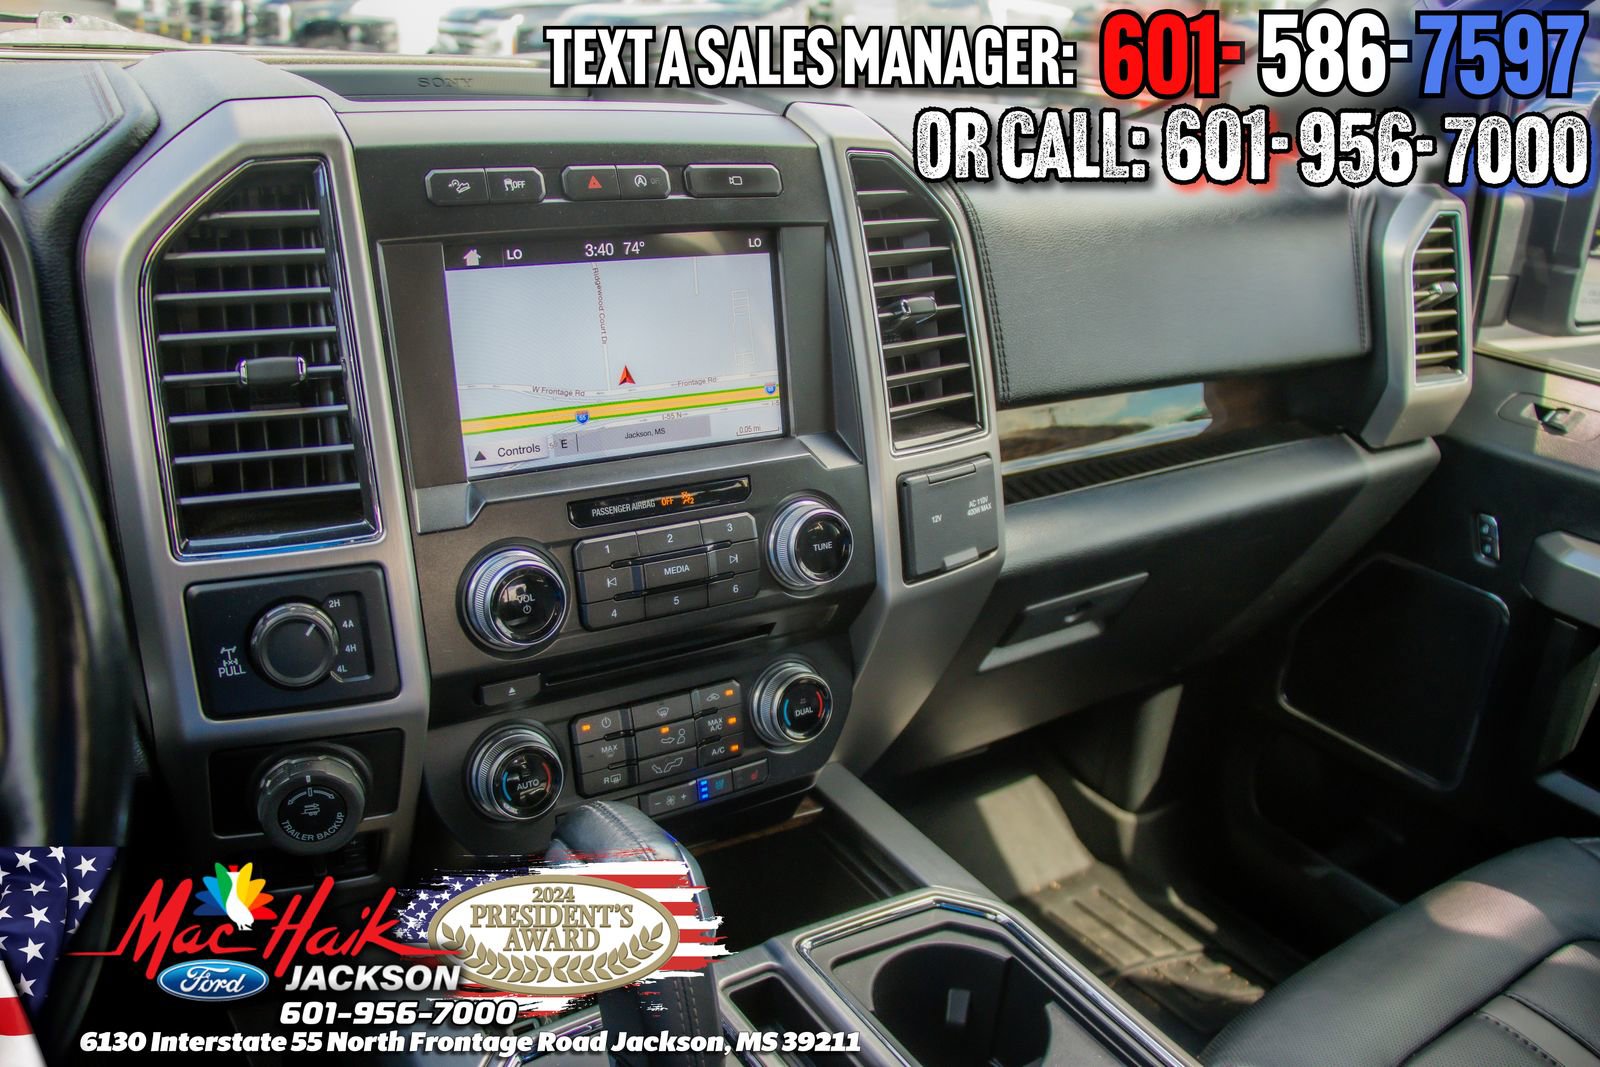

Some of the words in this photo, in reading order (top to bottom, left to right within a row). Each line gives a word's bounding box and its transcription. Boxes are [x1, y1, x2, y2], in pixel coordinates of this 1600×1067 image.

[416, 77, 473, 88] SONY
[512, 180, 526, 189] OFF
[748, 237, 762, 248] LO
[506, 248, 523, 260] LO
[584, 242, 615, 257] 3:40
[623, 241, 645, 255] 74°
[592, 267, 605, 311] Ridgewood
[598, 312, 607, 334] Court
[677, 378, 706, 387] Frontage
[708, 376, 717, 384] Rd
[532, 385, 541, 393] W
[541, 387, 573, 397] Frontage
[575, 389, 585, 397] Rd
[624, 430, 653, 440] Jackson,
[654, 428, 666, 436] MS
[738, 425, 753, 434] 0.05
[560, 439, 568, 449] E
[497, 443, 541, 458] Controls
[591, 502, 631, 517] PASSENGER
[631, 499, 656, 511] AIRBAG
[661, 497, 674, 506] OFF
[968, 499, 977, 509] AC
[981, 503, 992, 513] MAX
[931, 514, 942, 523] 12V
[727, 523, 734, 532] 3
[667, 534, 674, 543] 2
[604, 545, 611, 553] 1
[812, 541, 833, 552] TUNE
[664, 564, 690, 576] MEDIA
[732, 584, 739, 593] 6
[328, 599, 341, 608] 2H
[517, 594, 536, 604] VOL
[673, 596, 680, 605] 5
[611, 609, 618, 618] 4
[342, 620, 355, 629] 4A
[345, 643, 357, 653] 4H
[218, 666, 247, 678] PULL
[336, 664, 349, 674] 4L
[795, 706, 814, 717] DUAL
[708, 717, 723, 727] MAX
[710, 724, 723, 732] A/C
[601, 743, 618, 753] MAX
[711, 746, 726, 756] A/C
[517, 778, 540, 791] AUTO
[281, 819, 315, 841] TRAILER
[316, 811, 345, 841] BACKUP
